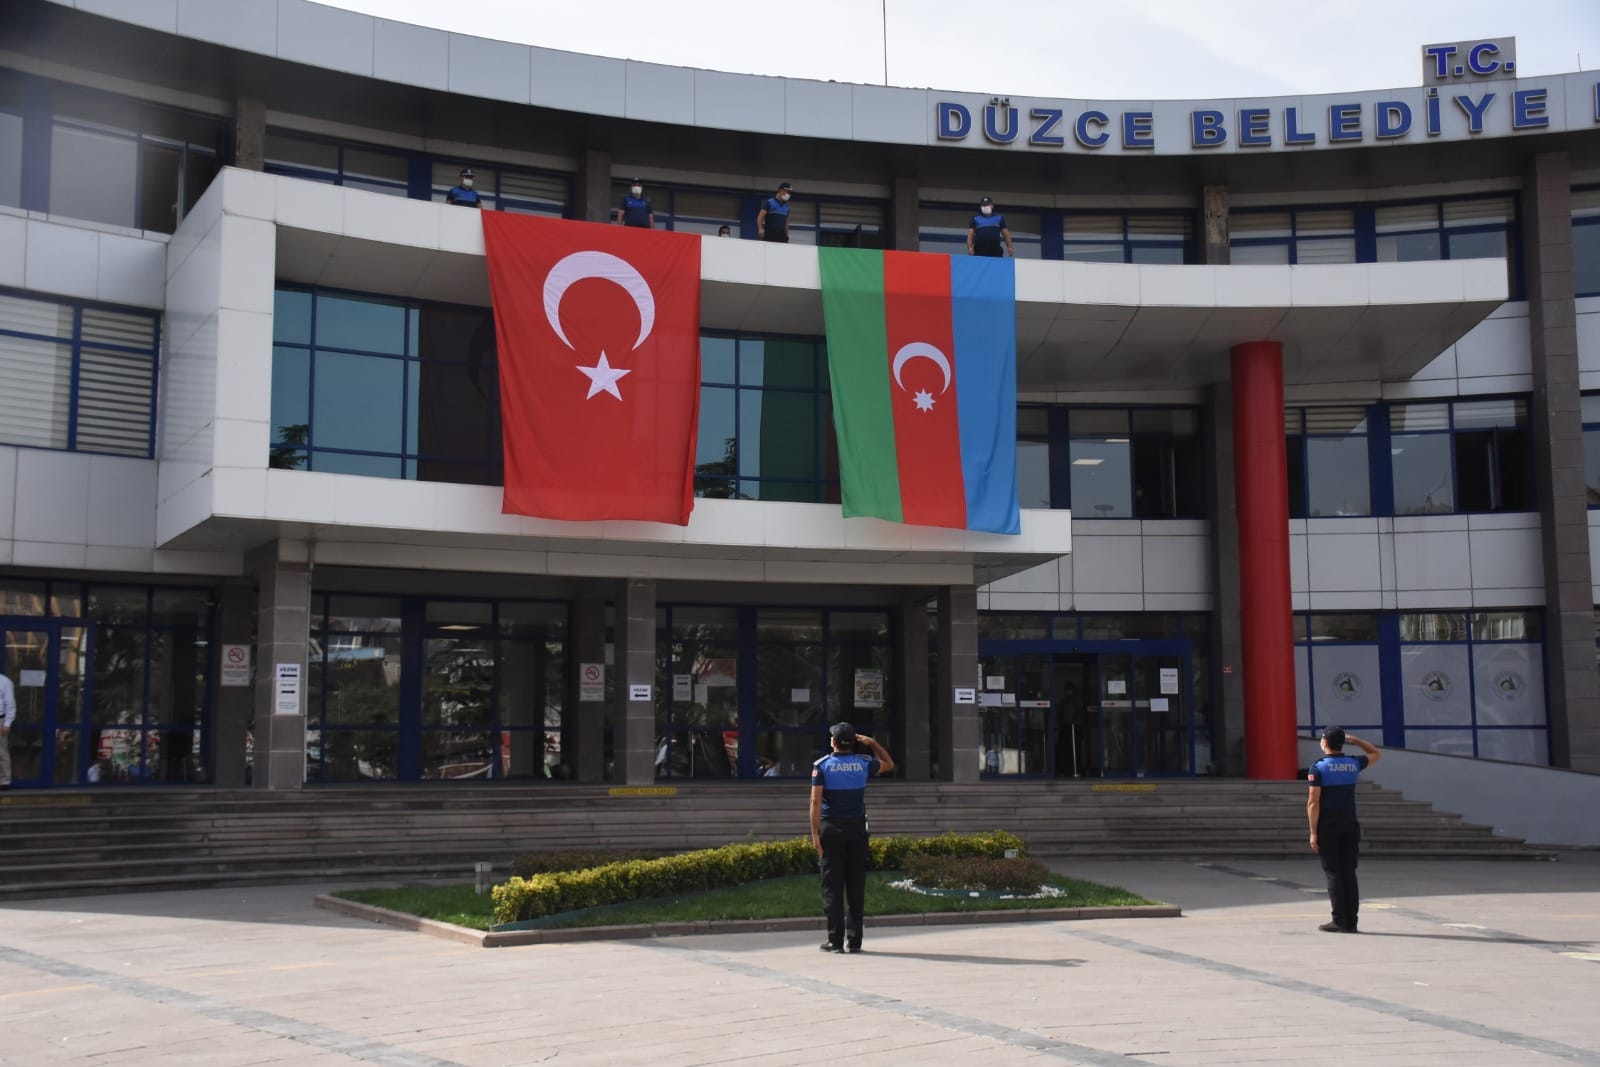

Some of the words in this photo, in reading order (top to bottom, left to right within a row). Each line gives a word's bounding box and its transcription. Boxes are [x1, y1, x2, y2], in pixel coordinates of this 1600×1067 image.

[1426, 43, 1515, 78] T.C.
[938, 97, 1155, 148] DÜZCE
[1190, 87, 1549, 148] BELEDİYE
[830, 762, 863, 772] ZABITA
[1328, 763, 1357, 772] ZABITA
